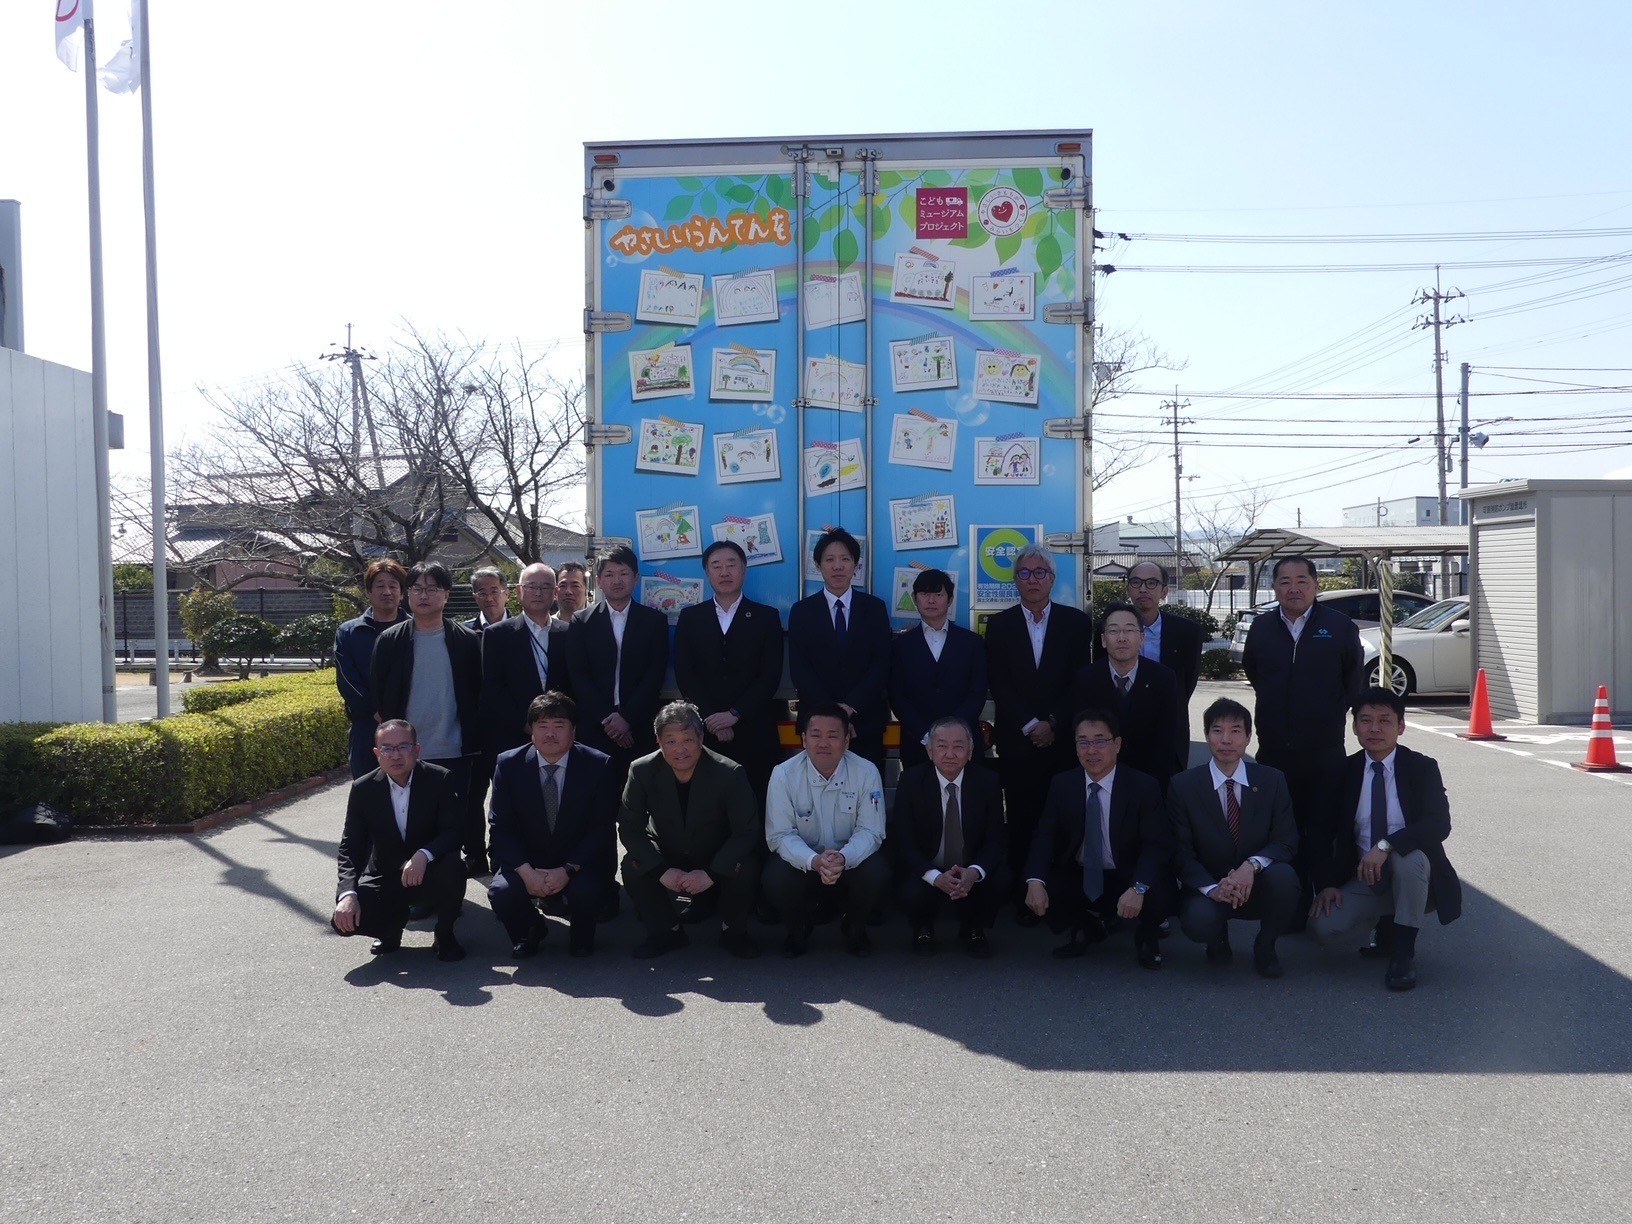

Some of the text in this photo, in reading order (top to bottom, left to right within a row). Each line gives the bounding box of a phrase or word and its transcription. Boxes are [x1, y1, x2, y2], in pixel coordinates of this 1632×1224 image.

[920, 196, 944, 206] こども
[920, 208, 965, 219] ミュージアム
[920, 221, 965, 232] プロジェクト
